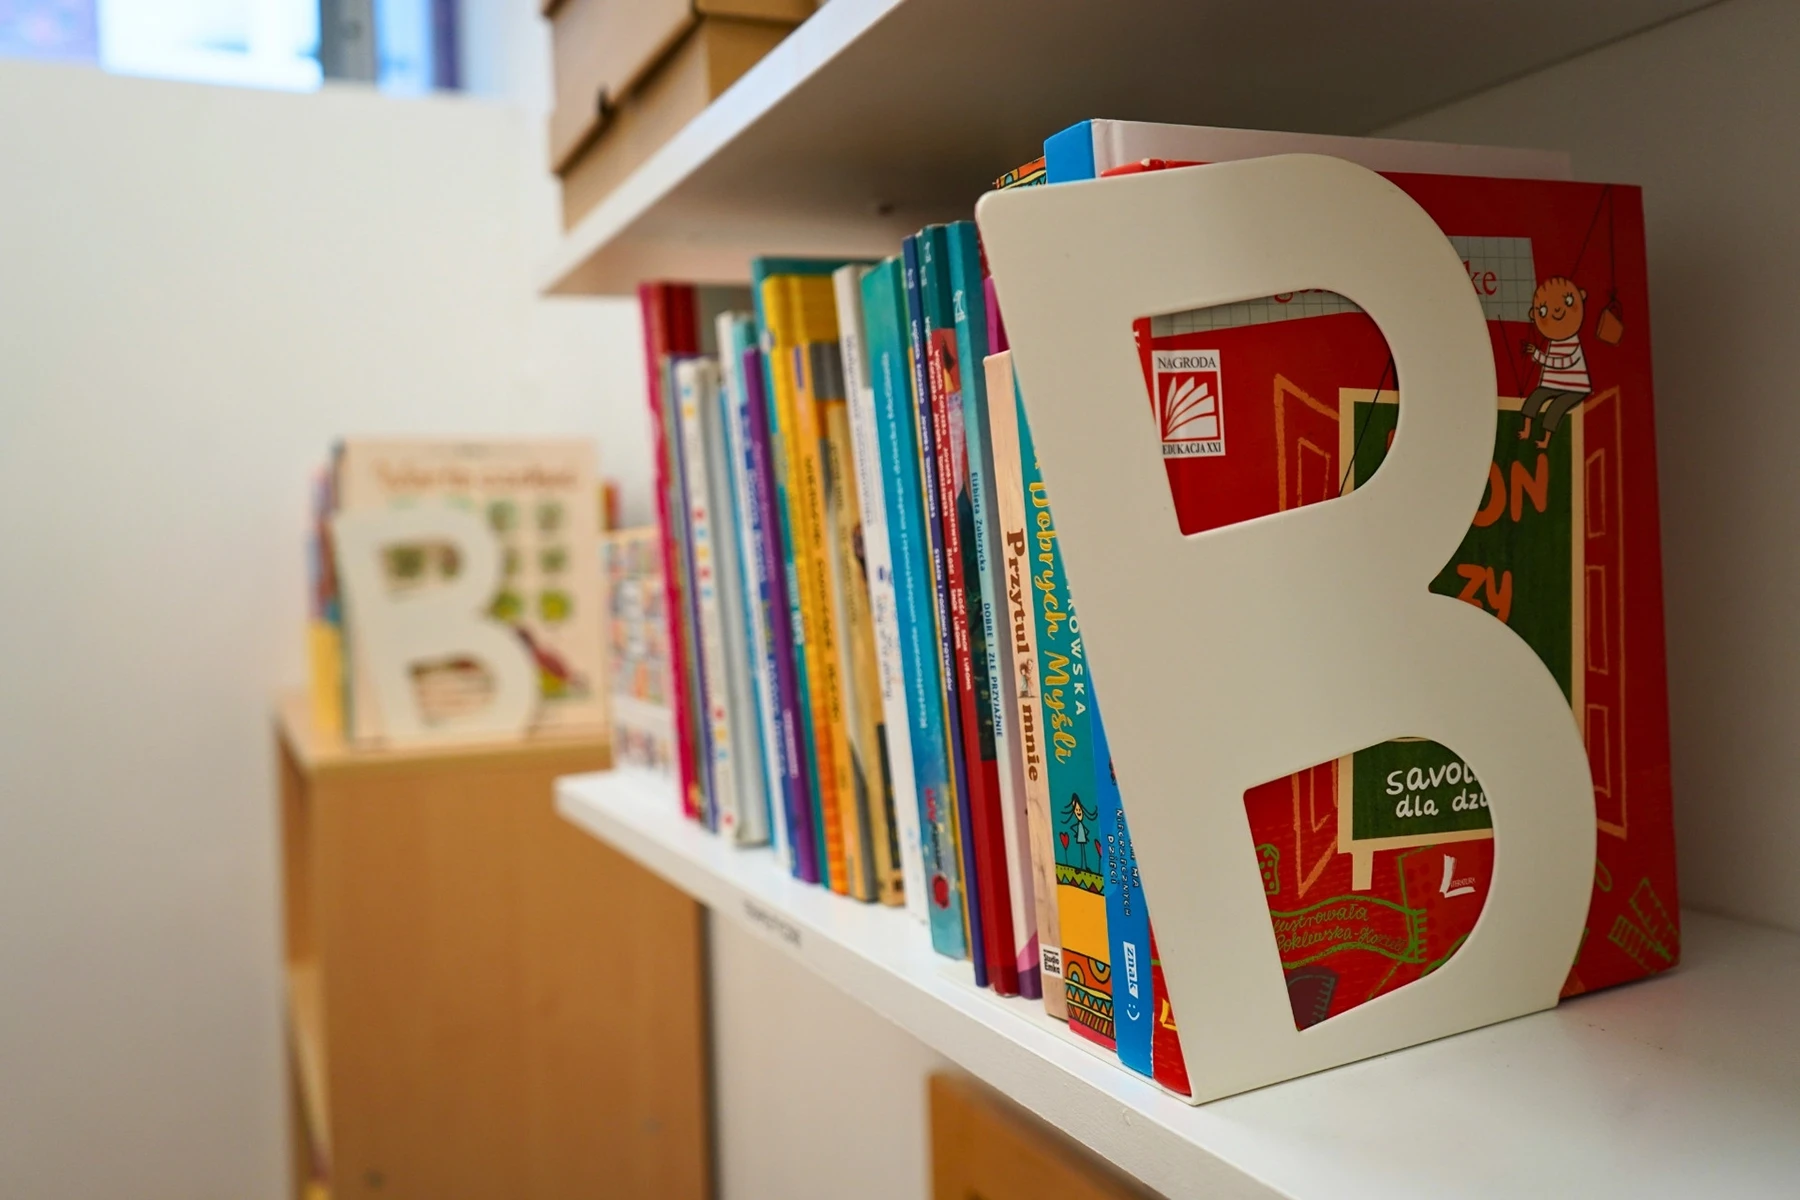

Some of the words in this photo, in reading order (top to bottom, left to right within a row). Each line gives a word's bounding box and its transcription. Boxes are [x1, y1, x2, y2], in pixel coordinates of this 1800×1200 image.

[1157, 355, 1217, 370] NAGRODA
[1162, 442, 1206, 455] EDUKACJA
[1206, 441, 1222, 454] XXI
[1472, 453, 1549, 528] ON
[975, 519, 987, 572] Zubrzycka
[983, 602, 994, 638] DOBRE
[1456, 563, 1513, 624] ZY
[1006, 528, 1030, 654] Przytul
[1022, 704, 1041, 782] mnie
[1067, 584, 1086, 716] KOWSKA
[1043, 650, 1077, 765] Myśli
[1395, 794, 1439, 818] dla
[1130, 865, 1139, 888] MA
